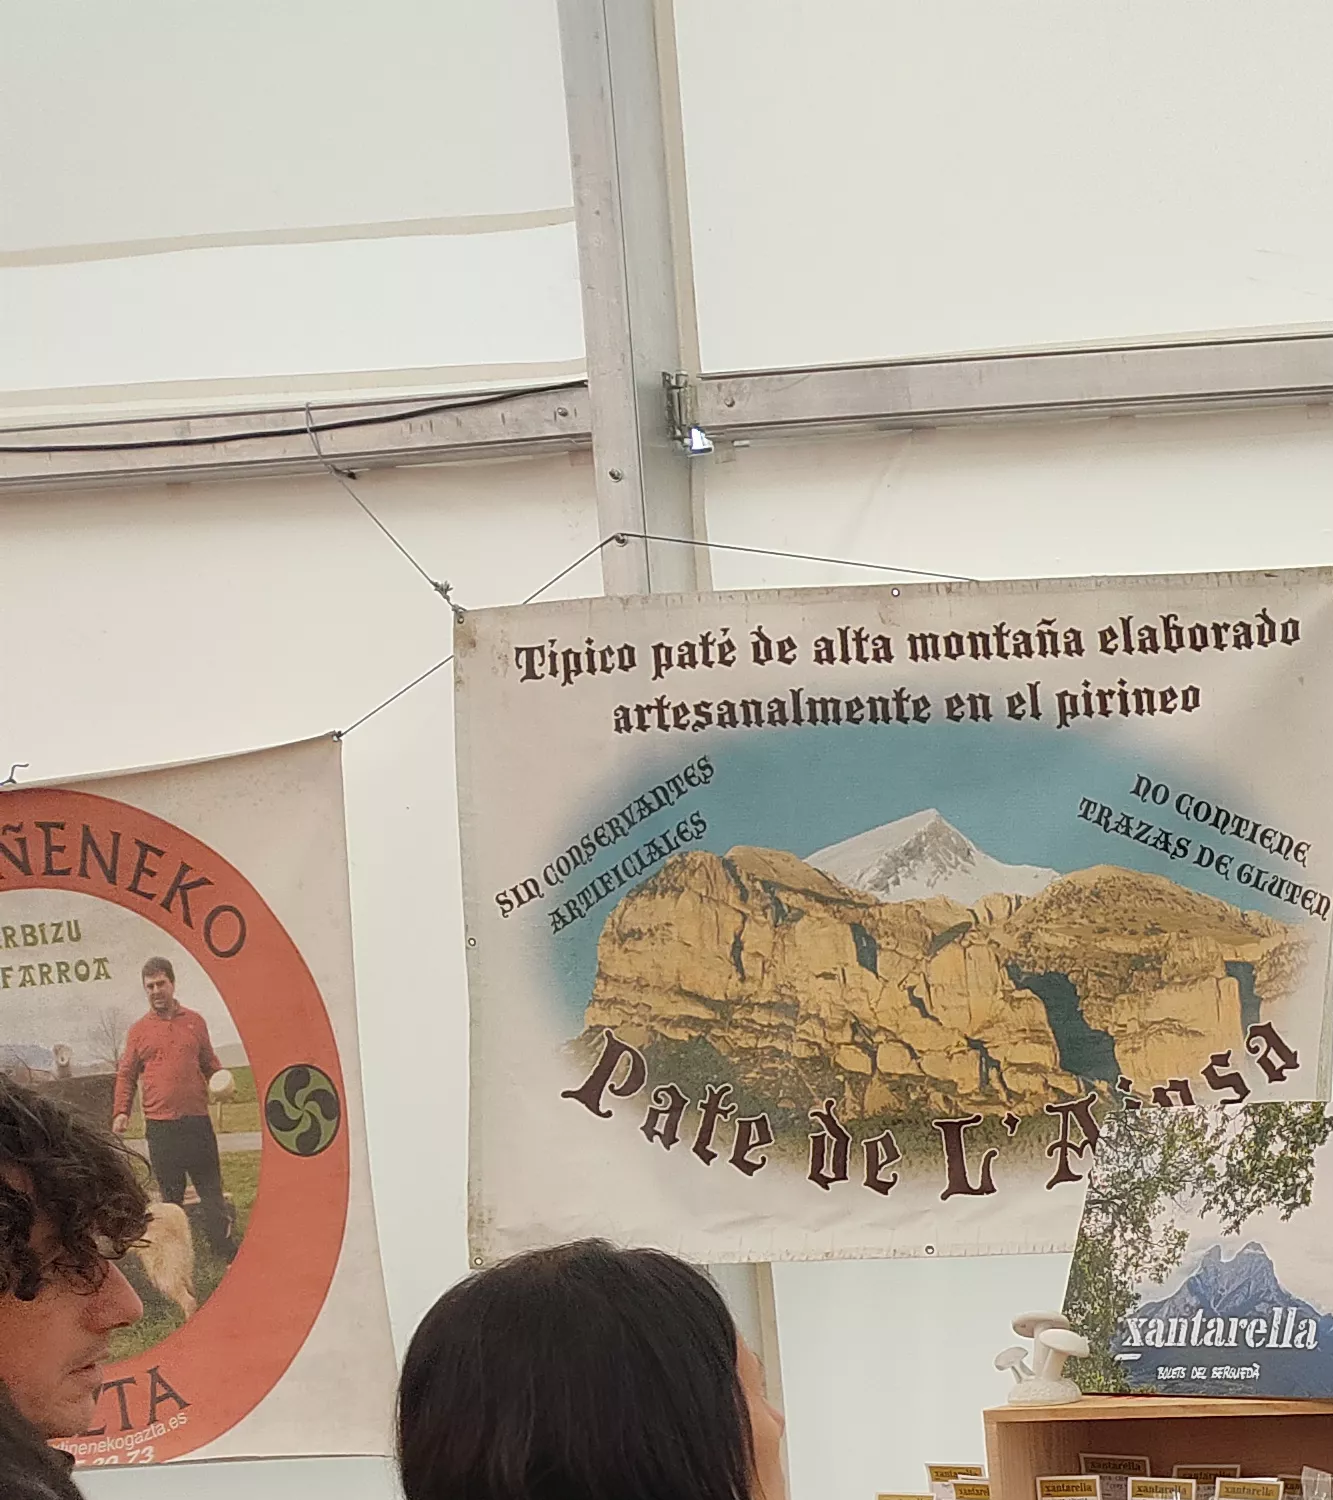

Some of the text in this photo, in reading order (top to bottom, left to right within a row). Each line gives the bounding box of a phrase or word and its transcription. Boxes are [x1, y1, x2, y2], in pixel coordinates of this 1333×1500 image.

[514, 608, 1301, 687] Típico paté de alta montaña elaborado
[613, 677, 1201, 734] artesanalmente en el pirineo
[495, 754, 715, 919] SIN CONSERVANTES
[1077, 797, 1331, 921] TRAZAS DE GLUTEN
[1130, 773, 1312, 868] NO CONTIENE
[547, 810, 707, 935] ARTIFICIALES
[0, 918, 82, 950] RBIZU
[560, 1027, 774, 1177] Pate
[807, 1099, 901, 1196] de
[1118, 1306, 1320, 1355] xantarella
[1045, 1481, 1093, 1494] xantarella
[1224, 1485, 1274, 1497] xantarella
